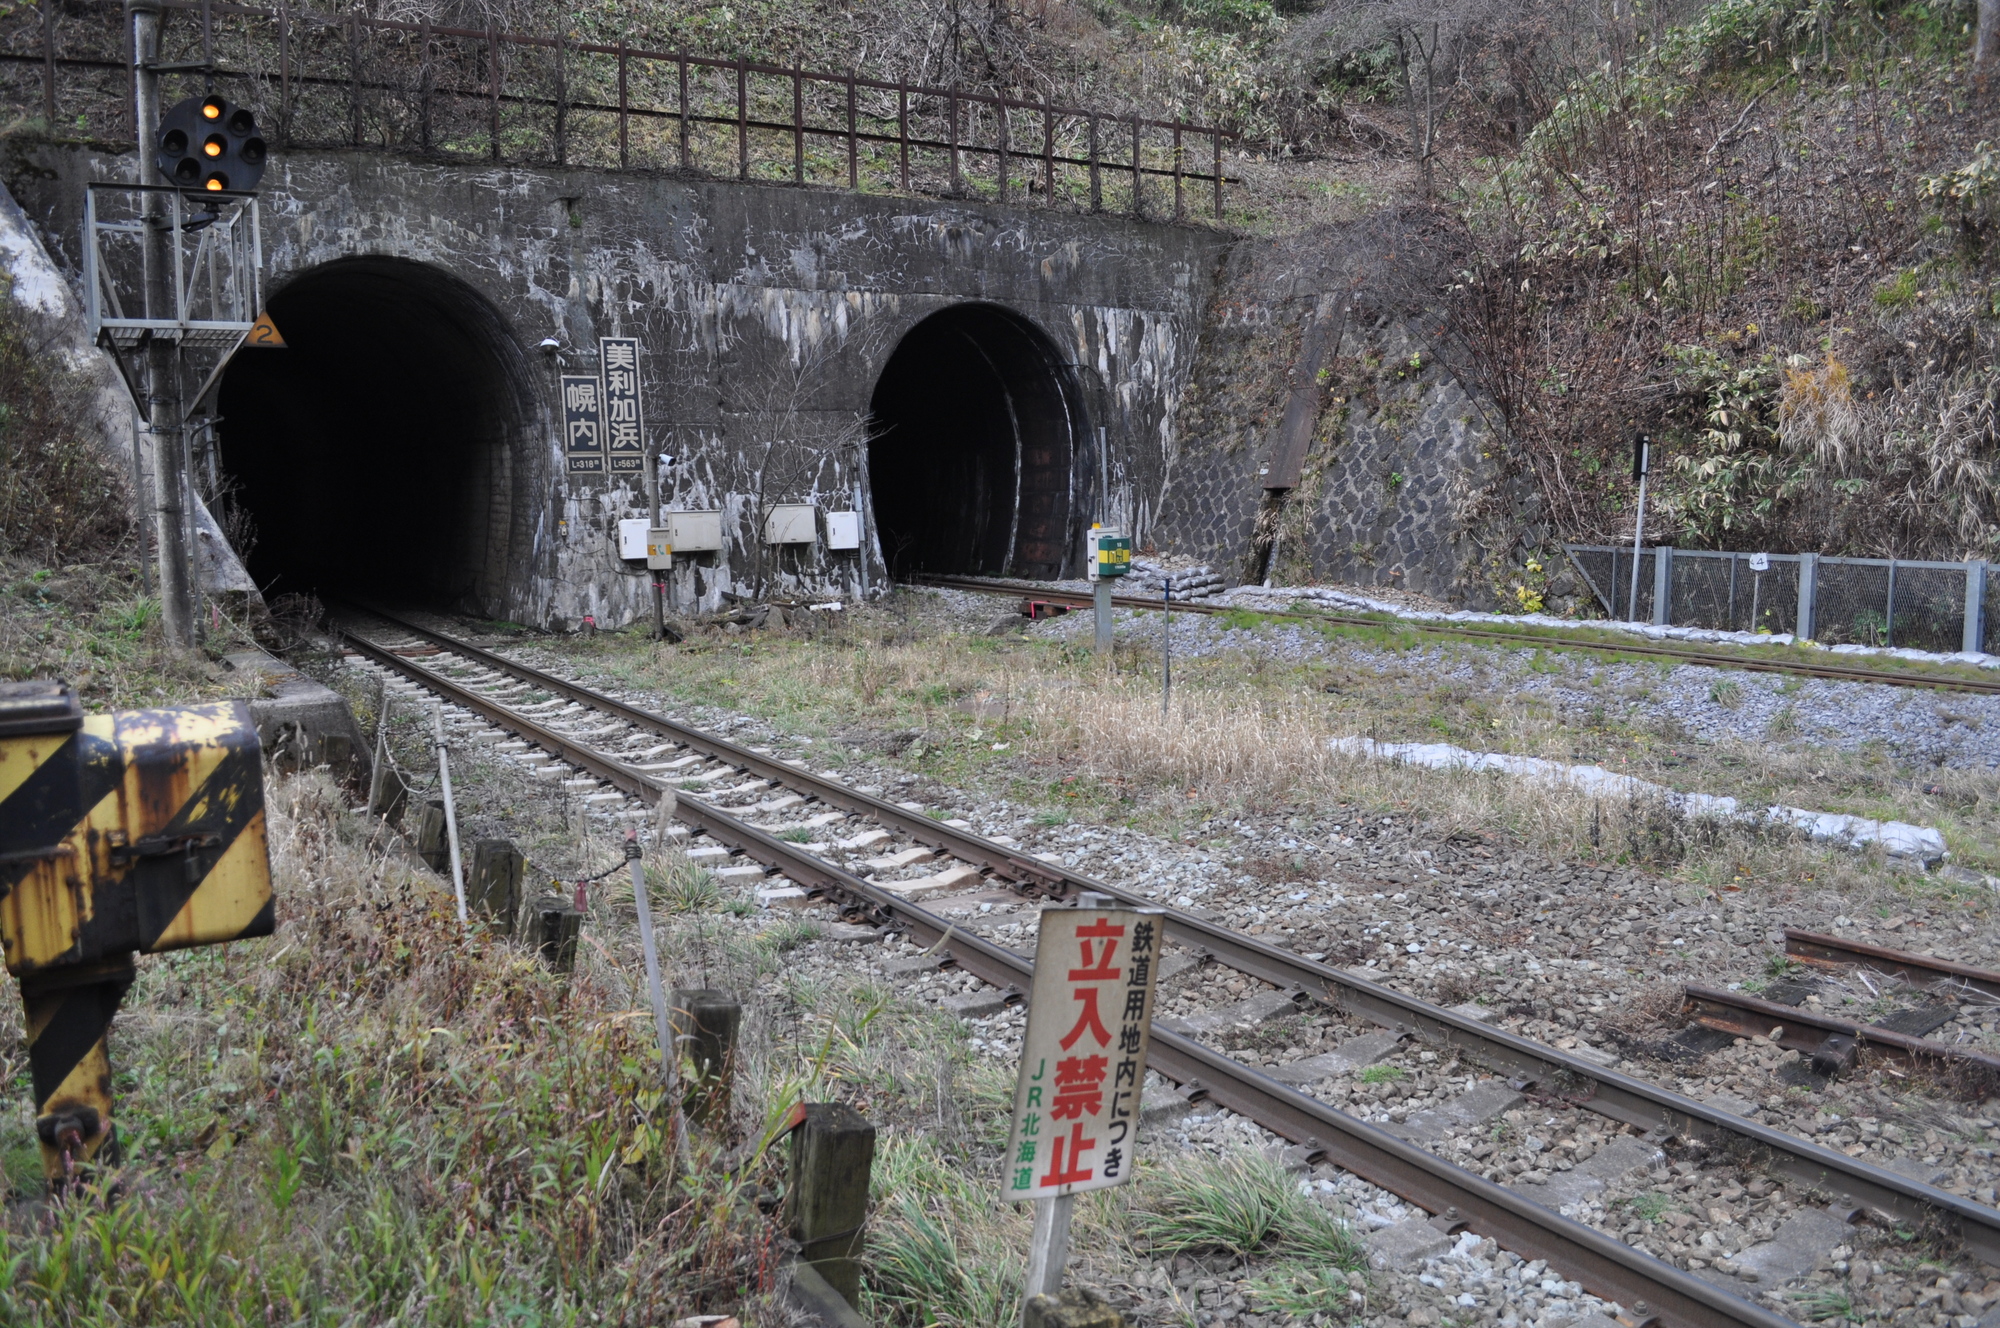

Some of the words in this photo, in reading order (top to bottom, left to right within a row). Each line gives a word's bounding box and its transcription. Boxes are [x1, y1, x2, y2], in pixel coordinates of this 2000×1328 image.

[256, 324, 273, 343] 2
[566, 383, 598, 447] 幌内
[606, 342, 640, 449] 美利加浜
[571, 460, 599, 469] L=318m
[613, 459, 641, 468] L=563m
[1040, 918, 1125, 1188] 立入禁止
[1103, 920, 1155, 1178] 鉄道用地内につき
[1010, 1058, 1045, 1191] JR北海道
